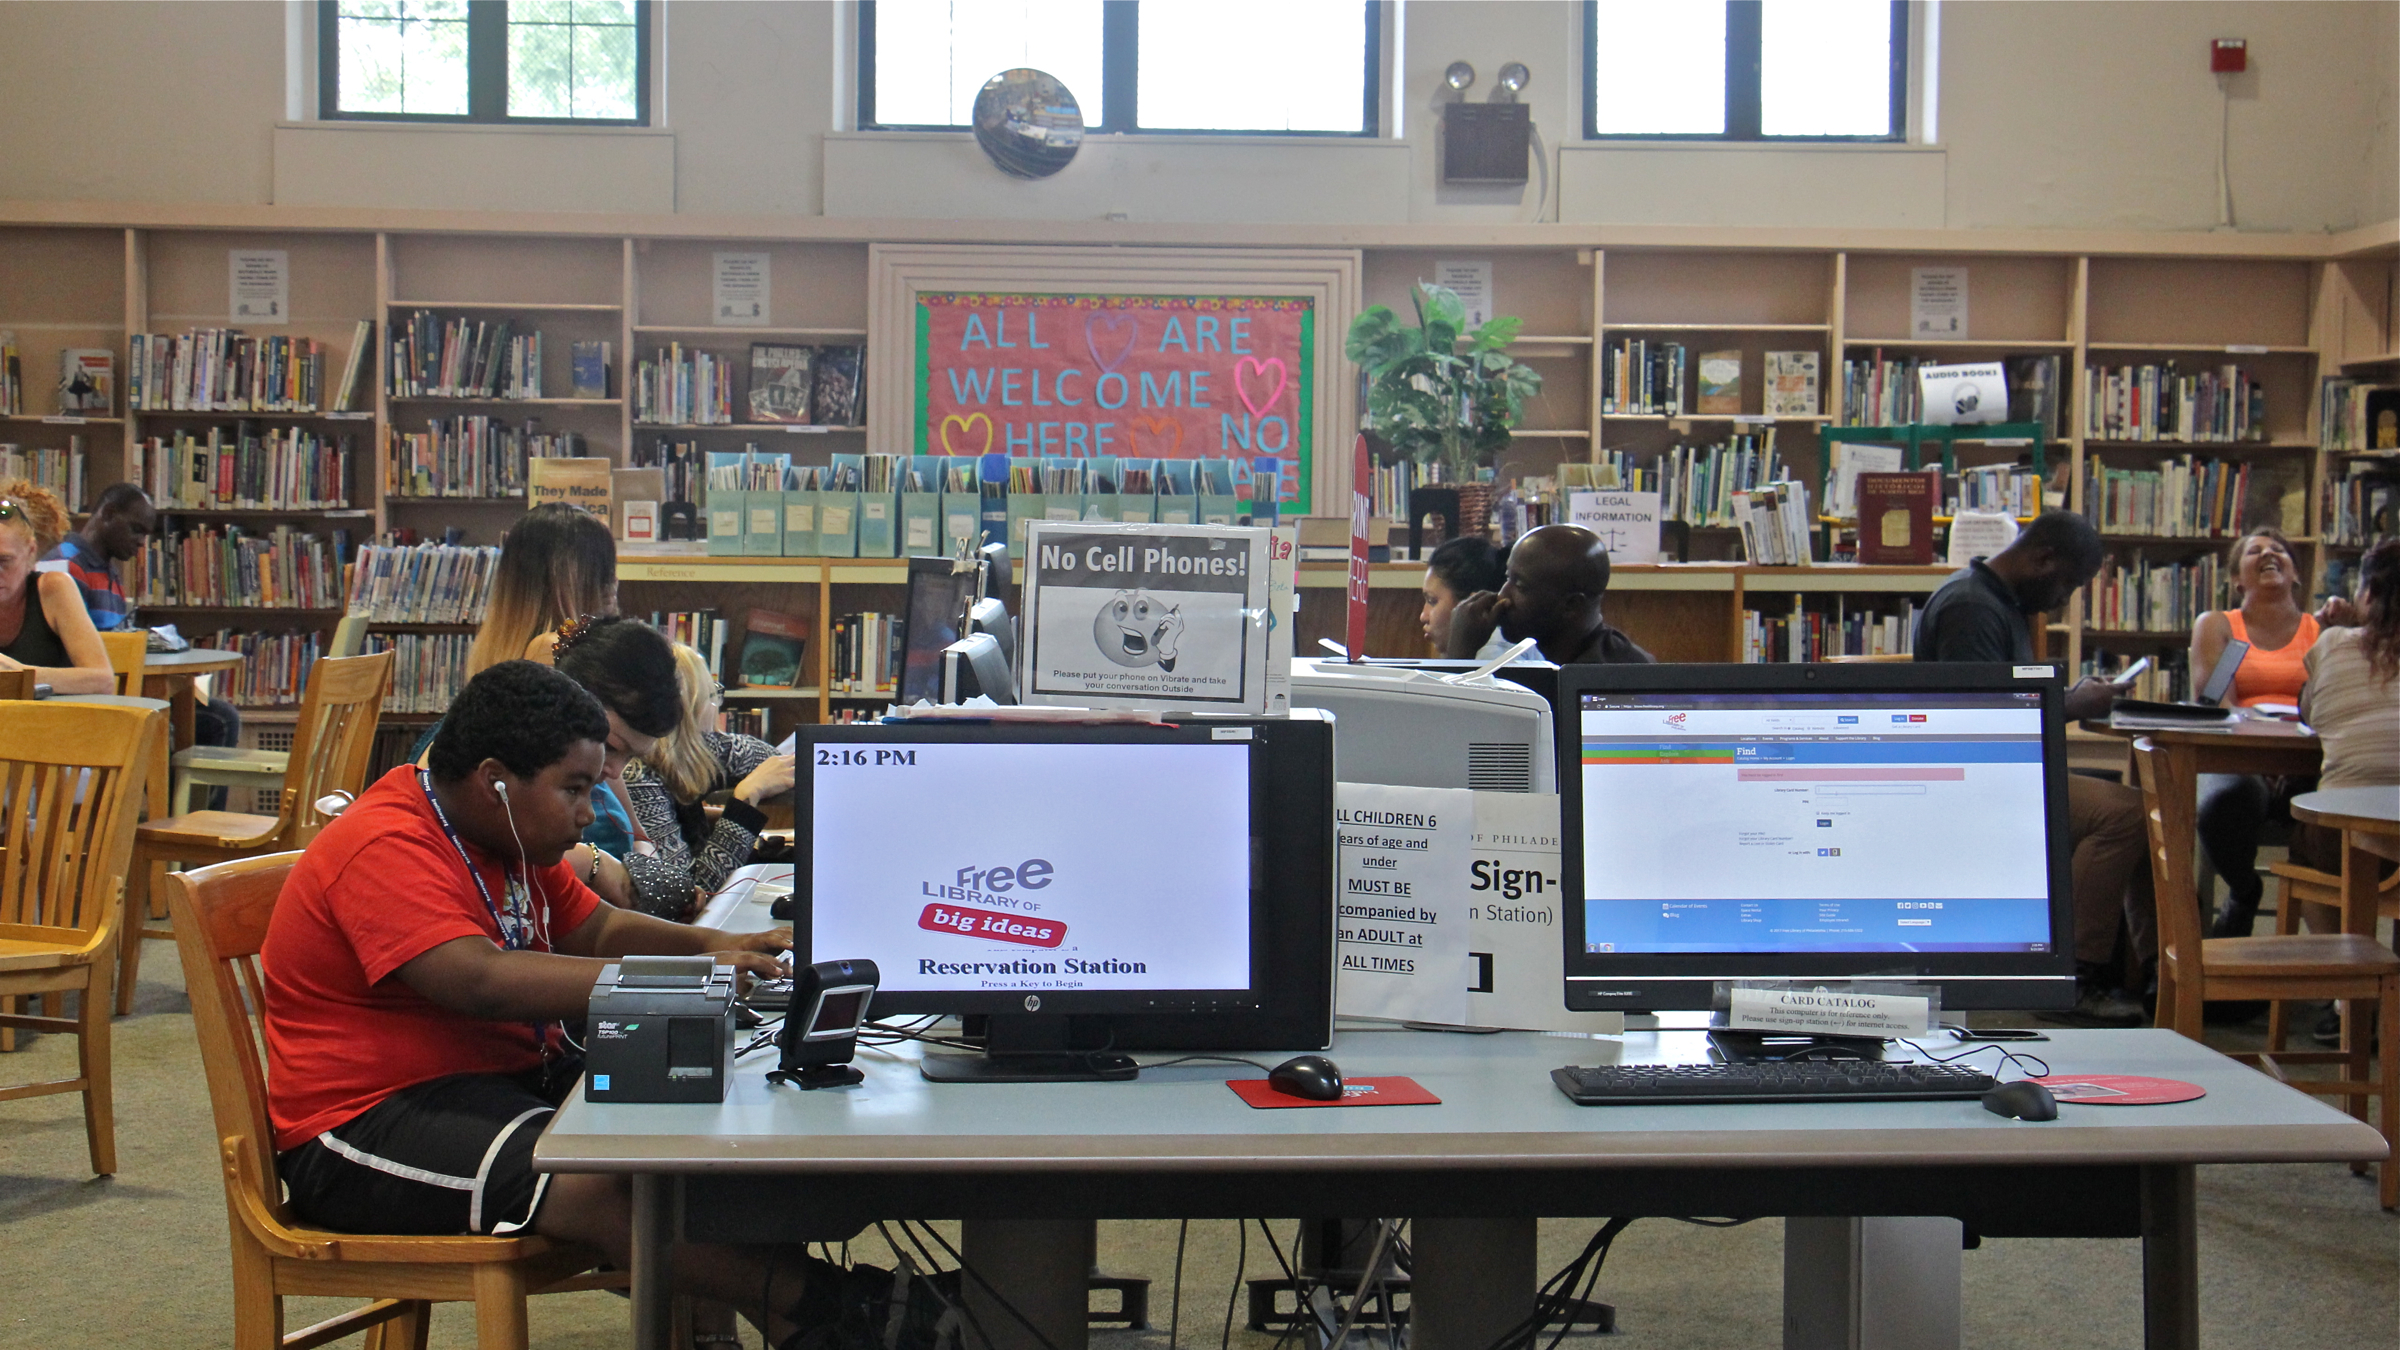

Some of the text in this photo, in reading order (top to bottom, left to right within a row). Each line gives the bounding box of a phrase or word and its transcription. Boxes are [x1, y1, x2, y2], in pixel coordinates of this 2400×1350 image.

[960, 311, 1252, 355] ALL ARE
[1925, 369, 1998, 379] AUDIO BOOKS
[947, 368, 1211, 410] WELCOME
[1005, 412, 1290, 459] HERE NO
[533, 485, 608, 498] They Made
[1595, 497, 1632, 506] LEGAL
[1575, 512, 1652, 522] INFORMATION
[1041, 545, 1246, 577] No Cell Phones!
[647, 567, 696, 578] Reference
[1053, 670, 1081, 680] Please
[1083, 672, 1097, 682] put
[1099, 673, 1118, 683] your
[1119, 673, 1146, 684] phone
[1160, 674, 1190, 683] Vibrate
[1191, 675, 1208, 684] and
[1209, 676, 1227, 685] take
[1085, 683, 1194, 693] your conversation Outside
[1669, 712, 1687, 723] Free
[817, 749, 917, 766] 2:16 PM
[1737, 747, 1756, 755] Find
[1354, 810, 1424, 827] CHILDREN
[1428, 815, 1437, 827] 6
[1367, 834, 1379, 845] of
[1382, 839, 1403, 850] age
[1405, 838, 1428, 849] and
[1362, 856, 1397, 867] under
[957, 858, 1054, 893] Free
[1470, 860, 1557, 900] Sign-
[1348, 879, 1411, 895] MUST BE
[922, 881, 1041, 912] LIBRARY OF
[1420, 908, 1437, 924] by
[1487, 904, 1553, 927] Station)
[933, 909, 1052, 940] big ideas
[1338, 929, 1423, 945] an ADULT at
[918, 958, 1147, 976] Reservation Station
[1342, 955, 1415, 972] ALL TIMES
[1020, 980, 1039, 989] Key
[1055, 980, 1083, 989] Begin
[1026, 995, 1040, 1011] hp
[1781, 995, 1876, 1009] CARD CATALOG
[1742, 1014, 1764, 1023] Please
[1778, 1017, 1804, 1026] sign-up
[1806, 1018, 1829, 1026] station
[1858, 1021, 1884, 1029] internet
[1769, 1007, 1785, 1015] This
[1786, 1008, 1818, 1017] computer
[1827, 1009, 1838, 1017] for
[1839, 1011, 1871, 1019] reference
[1873, 1012, 1890, 1021] only.
[598, 1021, 617, 1029] star
